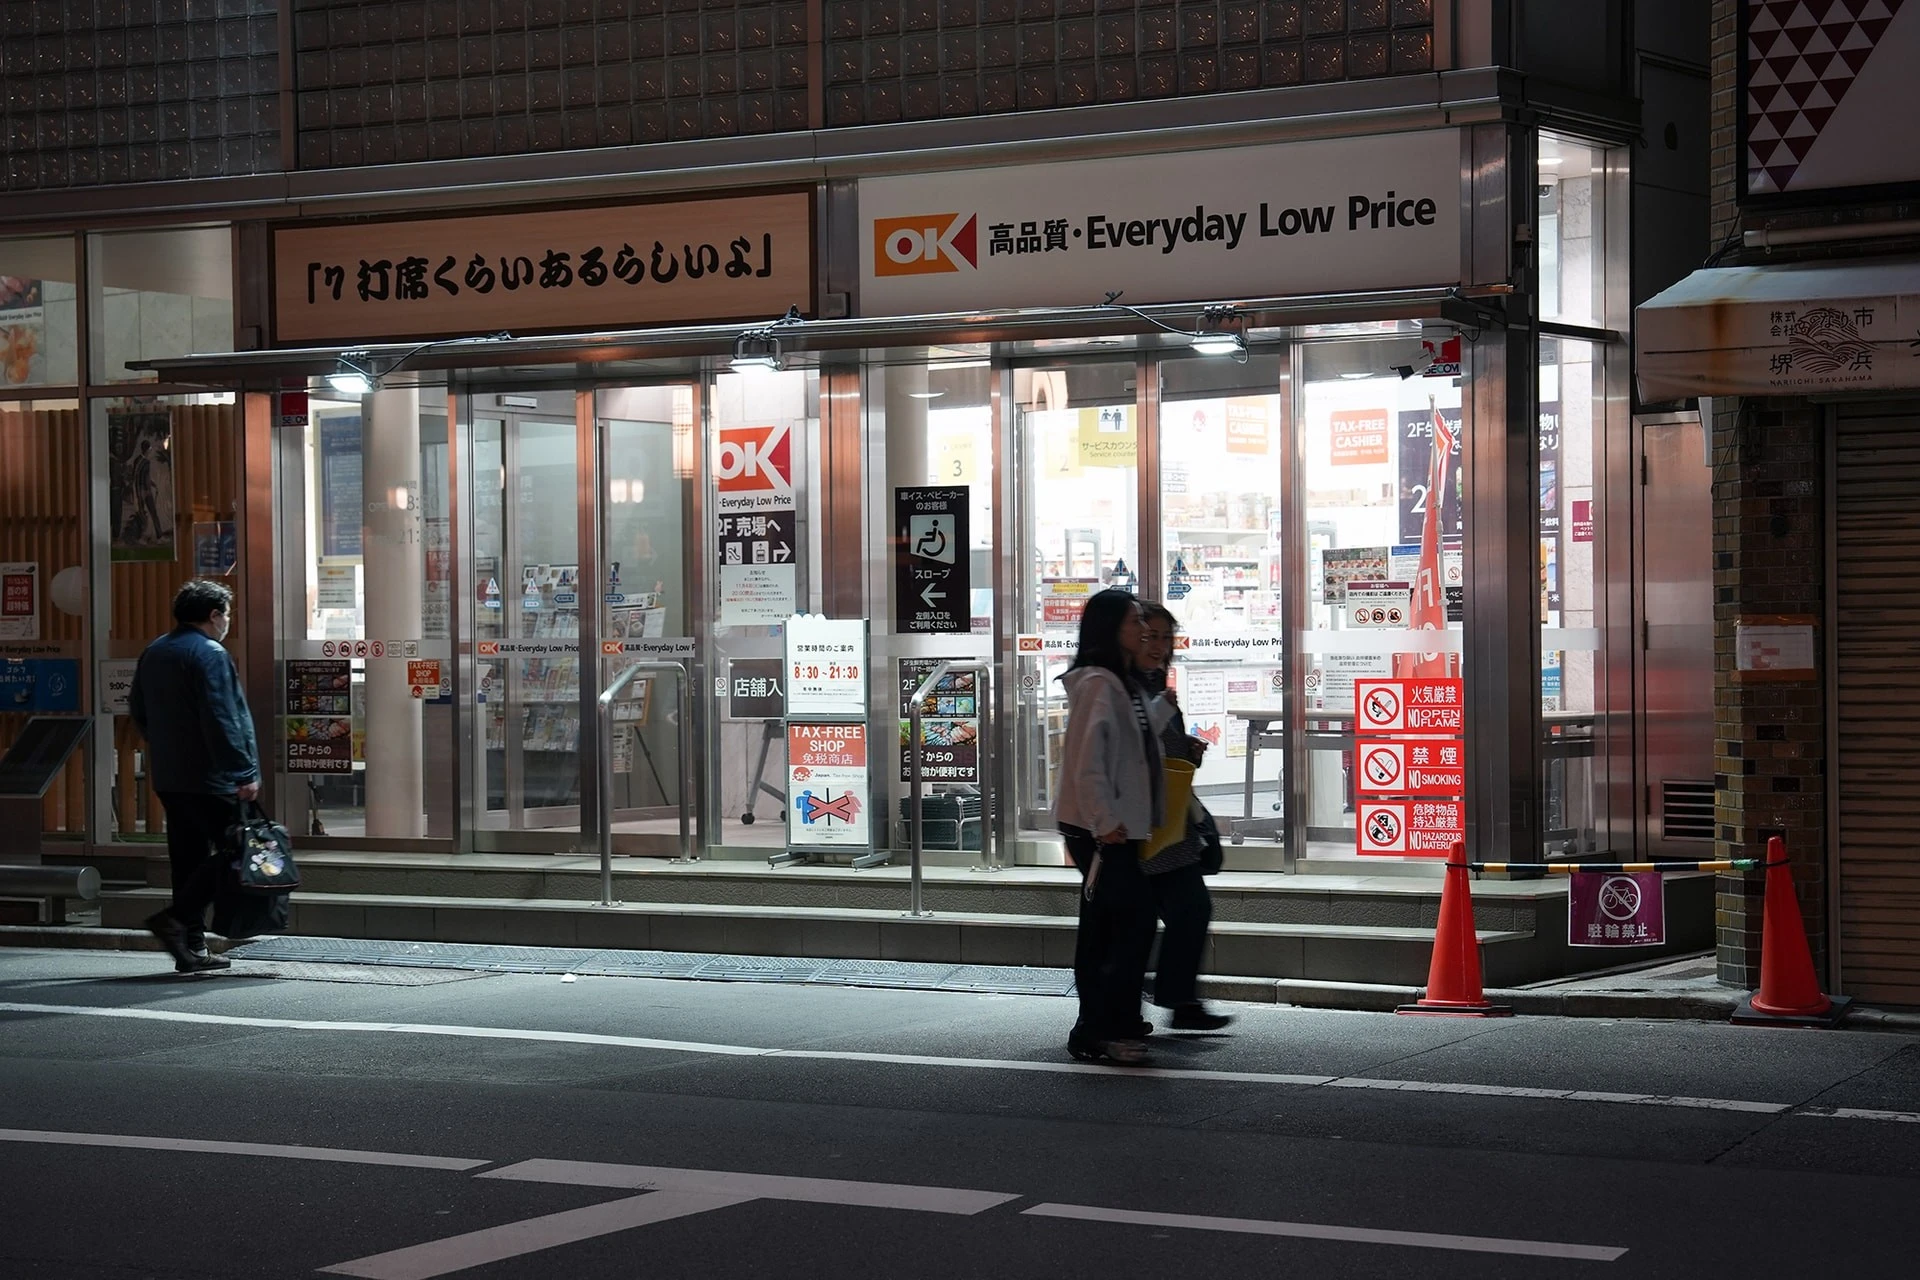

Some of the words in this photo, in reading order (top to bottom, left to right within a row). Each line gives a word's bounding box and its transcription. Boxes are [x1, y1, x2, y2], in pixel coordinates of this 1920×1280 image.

[1260, 193, 1336, 238] Low
[1348, 190, 1438, 231] Price
[883, 213, 977, 277] OK
[1770, 311, 1797, 324] 株式
[1770, 325, 1798, 337] 会社
[1770, 379, 1814, 387] NARIICHI
[1818, 375, 1873, 384] SAKAHAMA
[1333, 419, 1385, 433] TAX-FREE
[1335, 435, 1383, 448] CASHIER
[719, 427, 792, 489] OK
[1059, 455, 1069, 472] 2
[953, 459, 962, 477] 3
[756, 497, 772, 506] Low
[773, 494, 791, 505] Price
[900, 490, 964, 501] 車イス・ベビーカー
[915, 501, 948, 511] のお客様
[736, 516, 781, 536] 売場へ
[914, 568, 952, 580] スロープ
[915, 611, 951, 620] 左側入口を
[909, 620, 957, 630] ご利用ください
[479, 641, 498, 655] OK
[548, 644, 562, 653] Low
[564, 644, 579, 652] Price
[603, 641, 623, 654] OK
[675, 643, 690, 652] Low
[796, 644, 855, 653] 営業時間のご案内
[1019, 637, 1042, 651] OK
[1252, 638, 1268, 647] Low
[409, 661, 438, 670] TAX-FREE
[794, 665, 818, 679] 8:30
[829, 665, 859, 679] 21:30
[415, 669, 432, 678] SHOP
[288, 678, 301, 689] 2F
[733, 677, 784, 697] 店舗入
[902, 679, 916, 690] 2F
[1411, 685, 1457, 704] 火気厳禁
[288, 699, 300, 710] 1F
[1407, 709, 1420, 728] NO
[1420, 709, 1461, 718] OPEN
[1420, 718, 1461, 728] FLAME
[793, 726, 862, 739] TAX-FREE
[288, 744, 332, 756] 2Fからの
[809, 739, 845, 752] SHOP
[288, 758, 351, 769] お買物が便利です
[802, 752, 854, 765] 免税商店
[902, 766, 975, 777] お物が便利です
[1408, 770, 1421, 789] NO
[1422, 774, 1461, 786] SMOKING
[1412, 804, 1458, 817] 危険物品
[1412, 817, 1458, 829] 持込厳禁
[1409, 831, 1421, 850] NO
[1422, 832, 1462, 841] HAZARDOUS
[1587, 922, 1648, 939] 駐輪禁止
